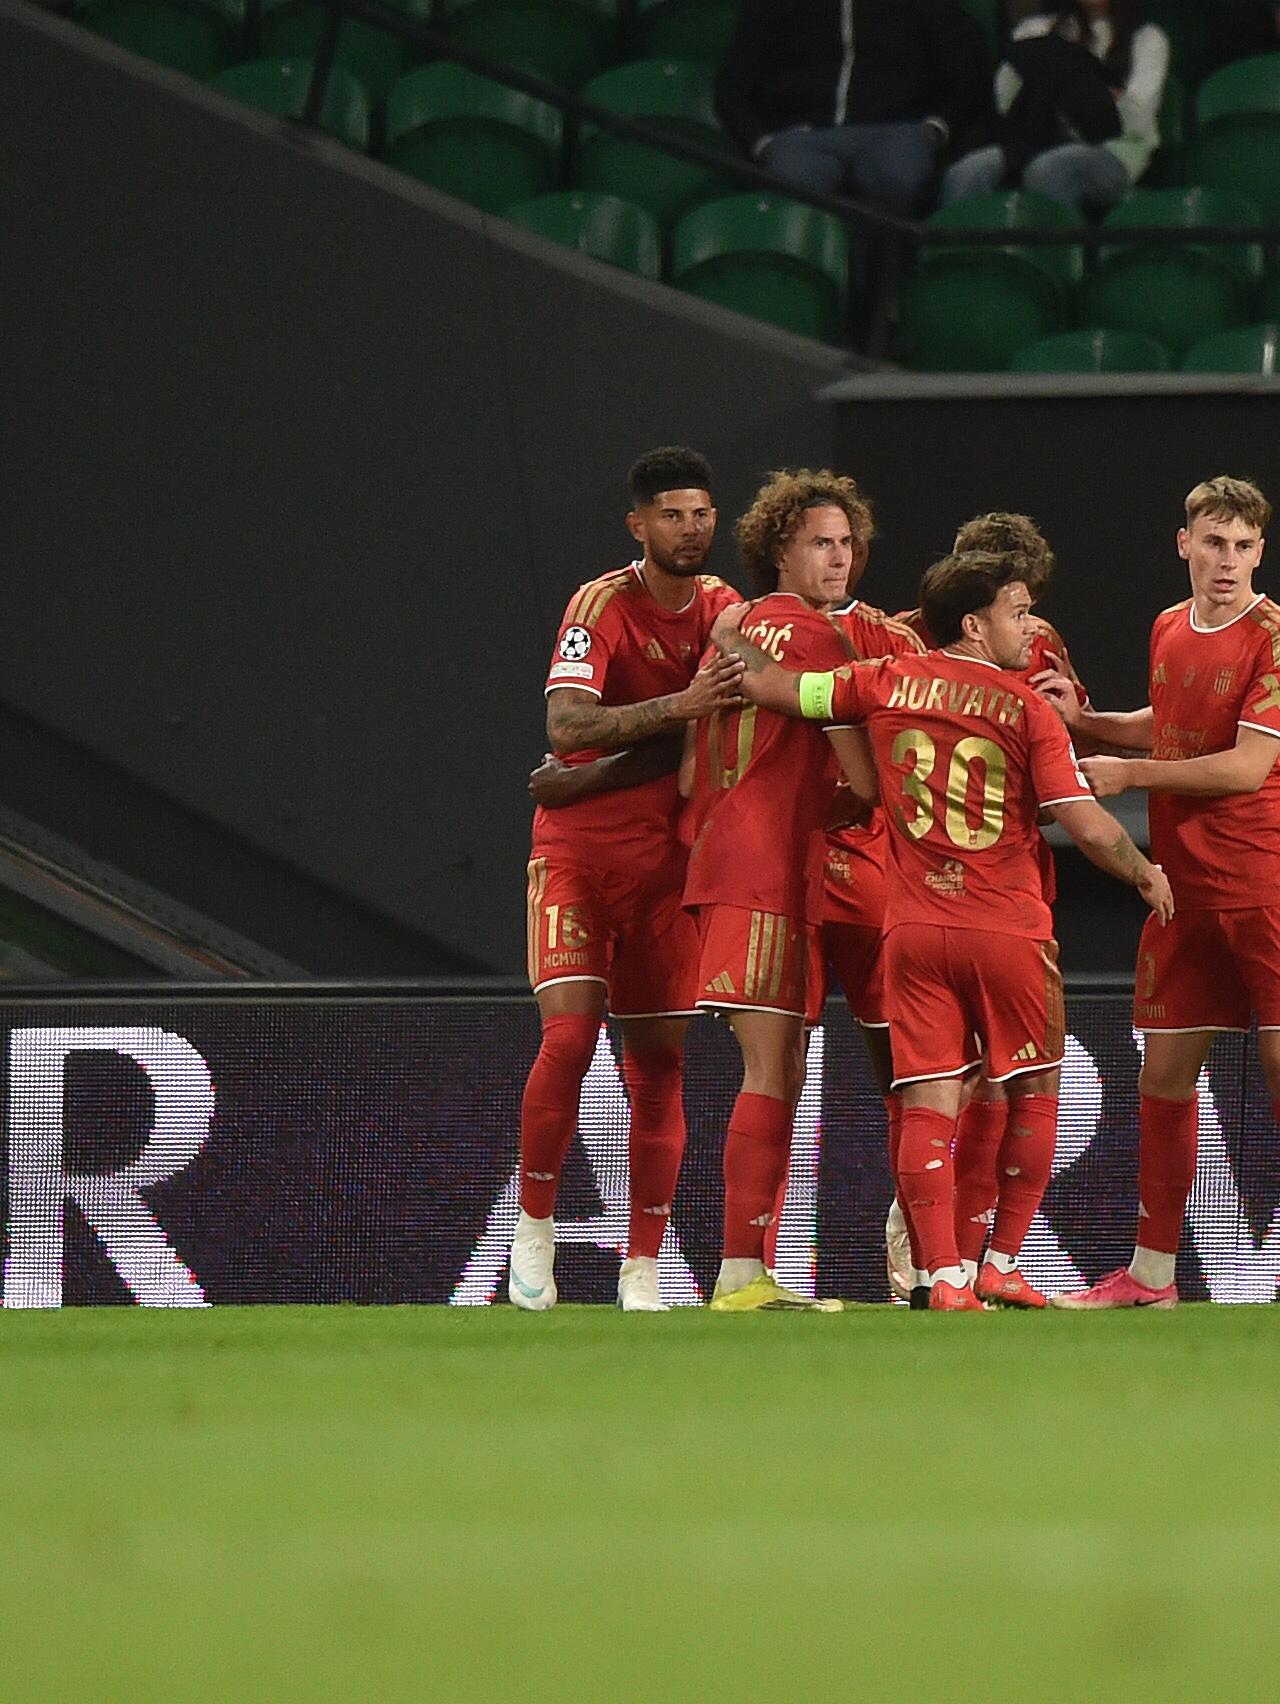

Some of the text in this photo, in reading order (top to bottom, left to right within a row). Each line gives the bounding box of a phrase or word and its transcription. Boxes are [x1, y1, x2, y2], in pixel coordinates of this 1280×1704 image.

[886, 675, 1025, 727] HORVATH
[891, 728, 1006, 851] 30
[545, 904, 588, 949] 16
